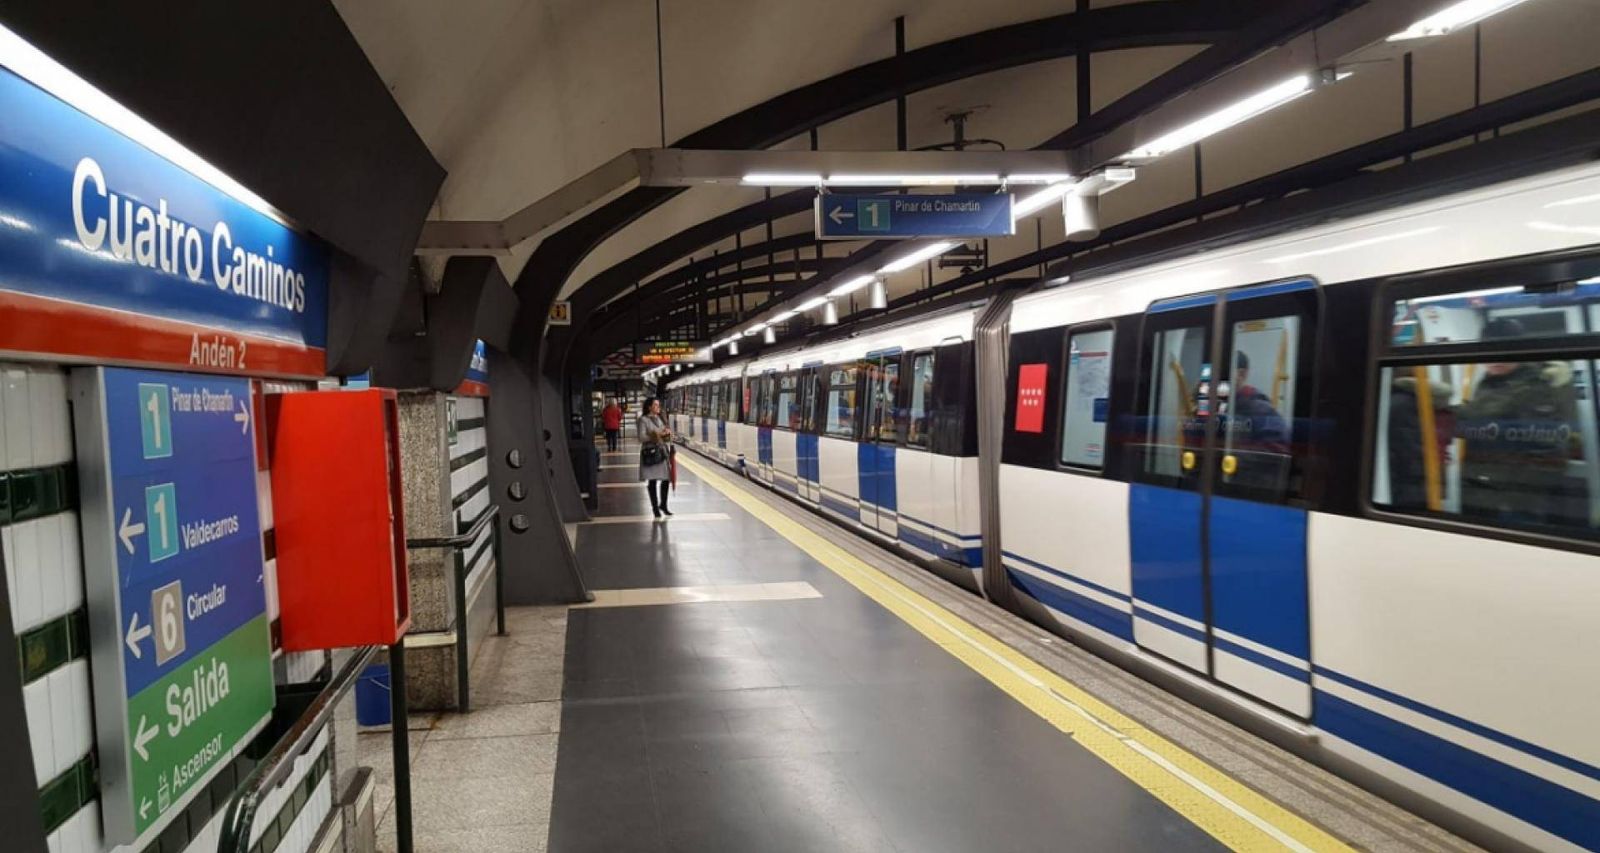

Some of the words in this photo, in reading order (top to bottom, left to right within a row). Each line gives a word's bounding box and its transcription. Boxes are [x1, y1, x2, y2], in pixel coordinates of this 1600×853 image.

[72, 157, 203, 282] Cuatro
[212, 221, 304, 313] Caminos
[866, 203, 878, 227] 1
[895, 200, 920, 212] Pinar
[921, 200, 932, 212] de
[190, 332, 236, 368] Andén
[238, 341, 246, 369] 2
[147, 391, 162, 448] 1
[171, 386, 192, 411] Pinar
[192, 387, 202, 411] de
[154, 492, 168, 549] 1
[181, 515, 239, 549] Valdecarros
[161, 593, 177, 651] 6
[187, 584, 226, 620] Circular
[166, 657, 230, 737] Salida
[173, 733, 222, 793] Ascensor
